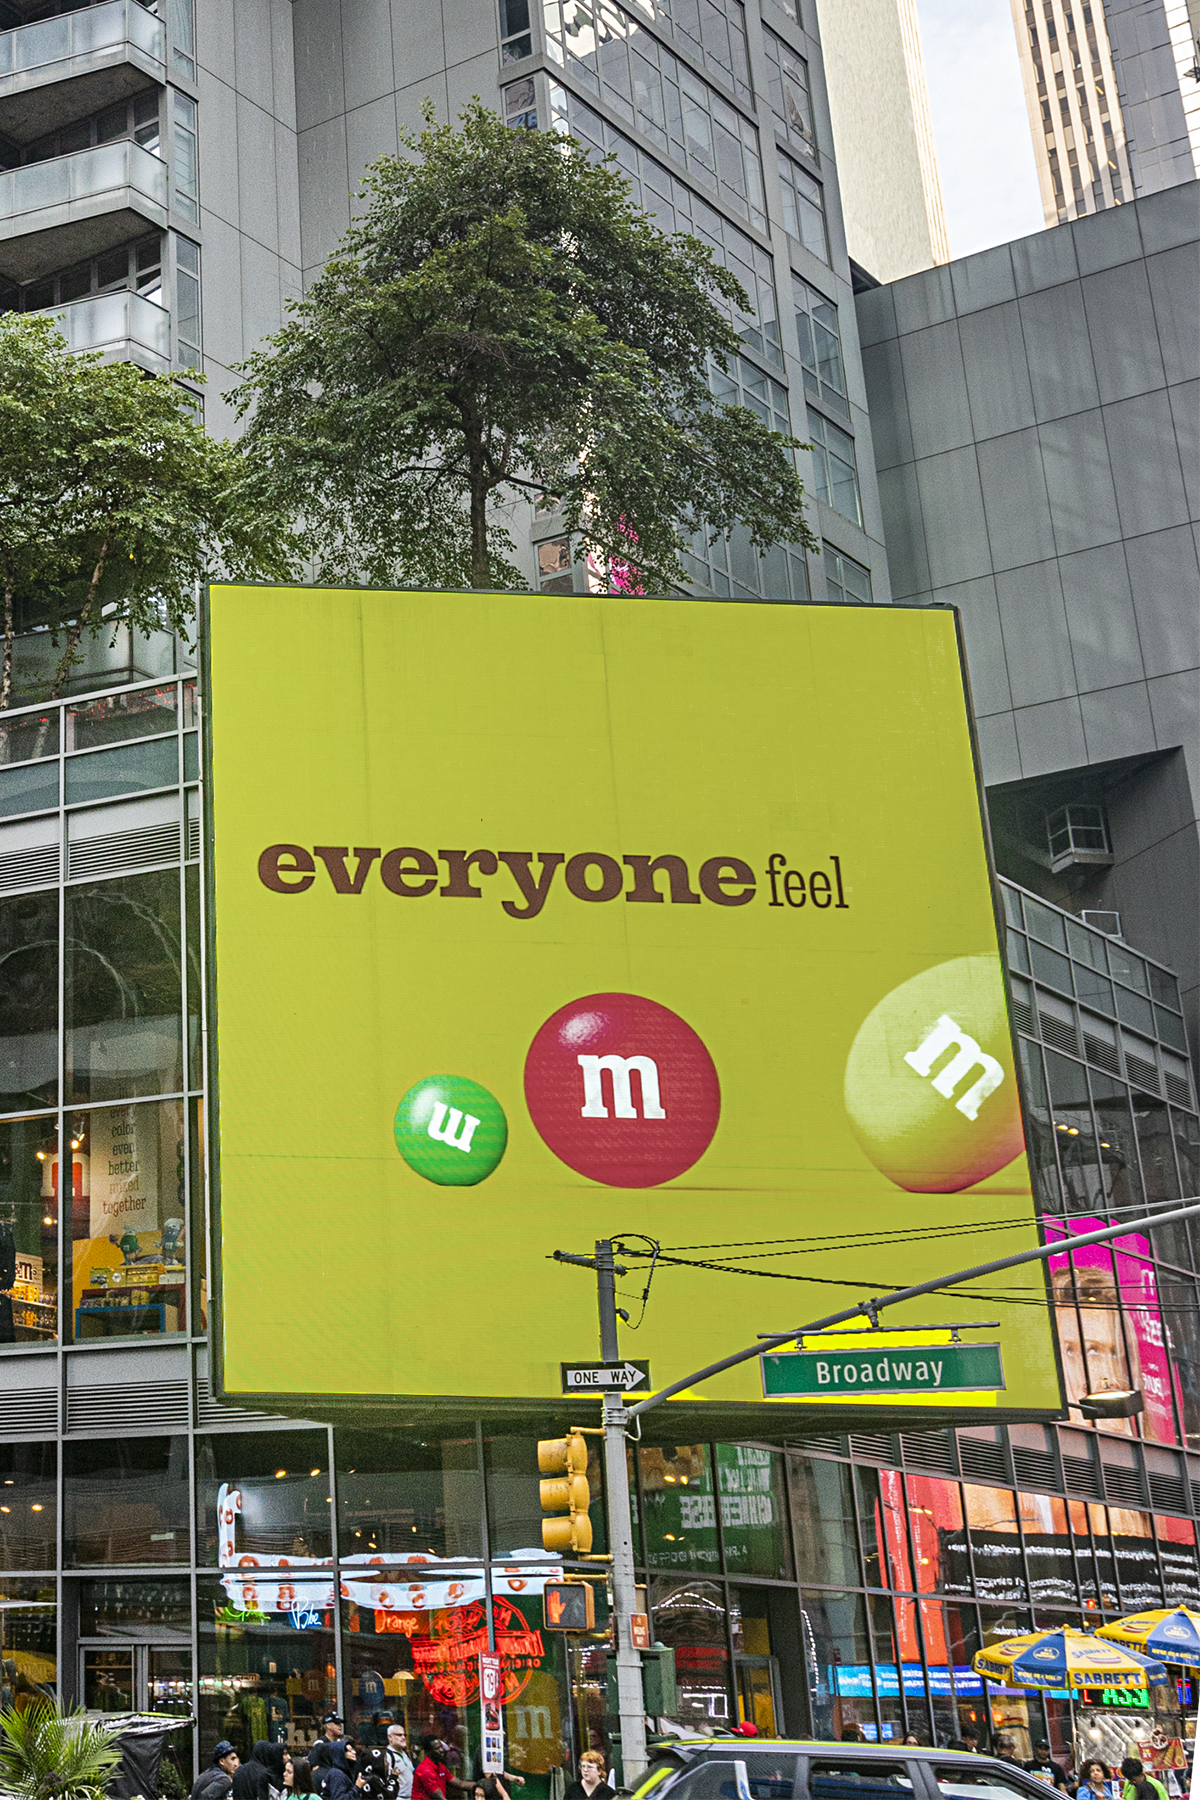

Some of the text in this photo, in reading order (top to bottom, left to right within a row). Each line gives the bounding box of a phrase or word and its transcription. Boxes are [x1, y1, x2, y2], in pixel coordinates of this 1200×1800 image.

[257, 843, 849, 919] everyone feel
[903, 1013, 1005, 1122] m
[577, 1053, 666, 1120] m
[111, 1121, 135, 1138] color
[108, 1160, 139, 1176] better
[102, 1195, 147, 1218] together
[573, 1369, 638, 1384] ONE WAY
[816, 1359, 943, 1385] Broadway
[1073, 1672, 1141, 1685] SABRETT
[514, 1704, 553, 1739] m
